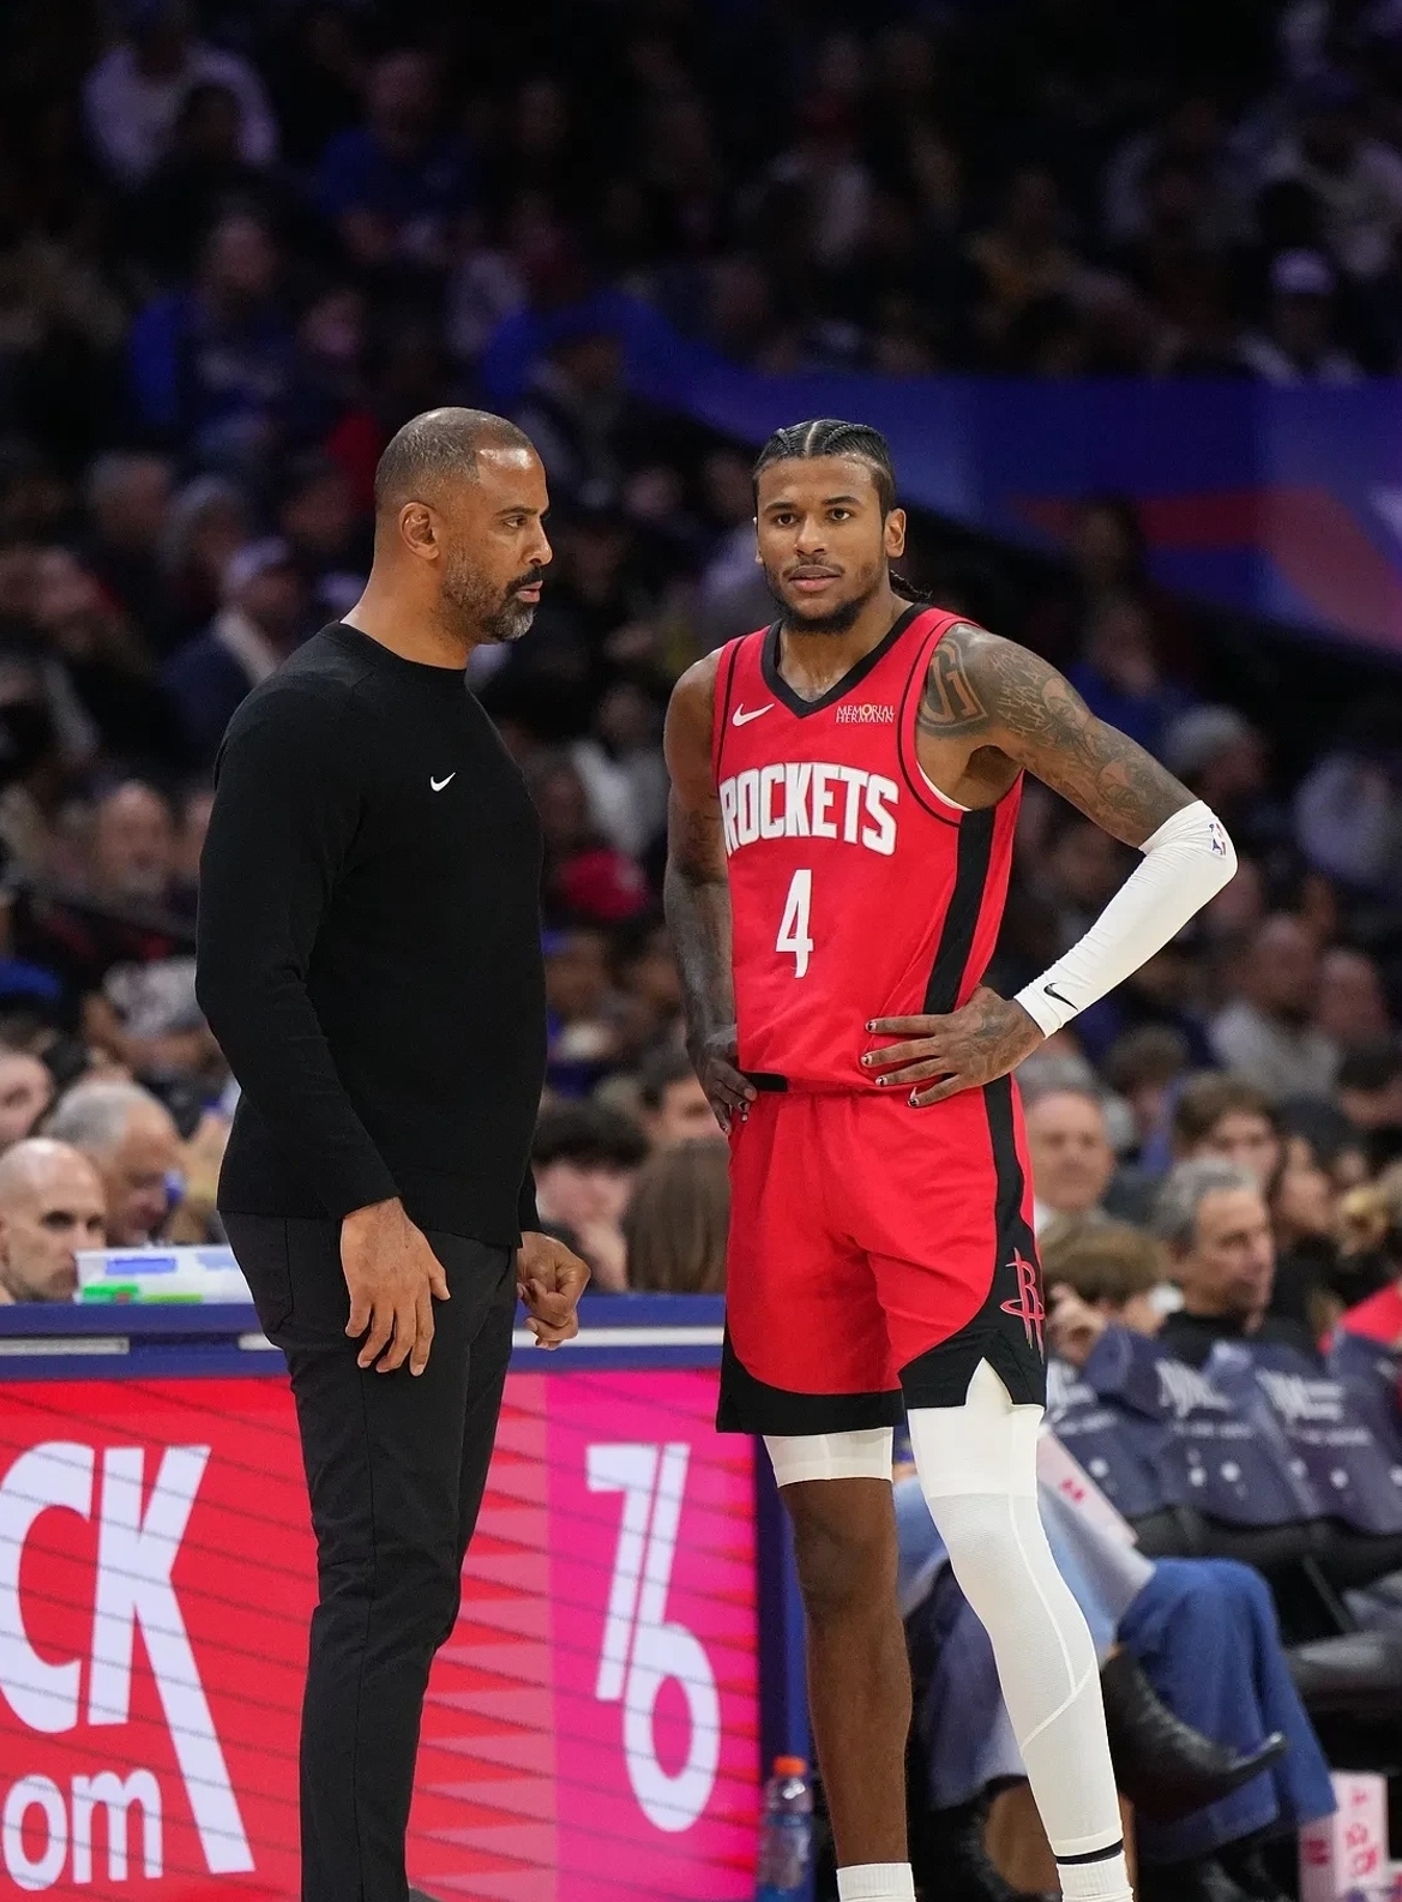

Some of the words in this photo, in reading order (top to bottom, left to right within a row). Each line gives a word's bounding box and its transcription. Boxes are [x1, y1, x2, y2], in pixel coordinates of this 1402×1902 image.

[836, 704, 895, 716] MEMORIAL
[836, 713, 893, 723] HERMANN
[719, 761, 899, 857] ROCKETS
[775, 869, 814, 978] 4
[0, 1441, 255, 1873] CK
[586, 1442, 721, 1832] 76
[2, 1768, 163, 1890] om
